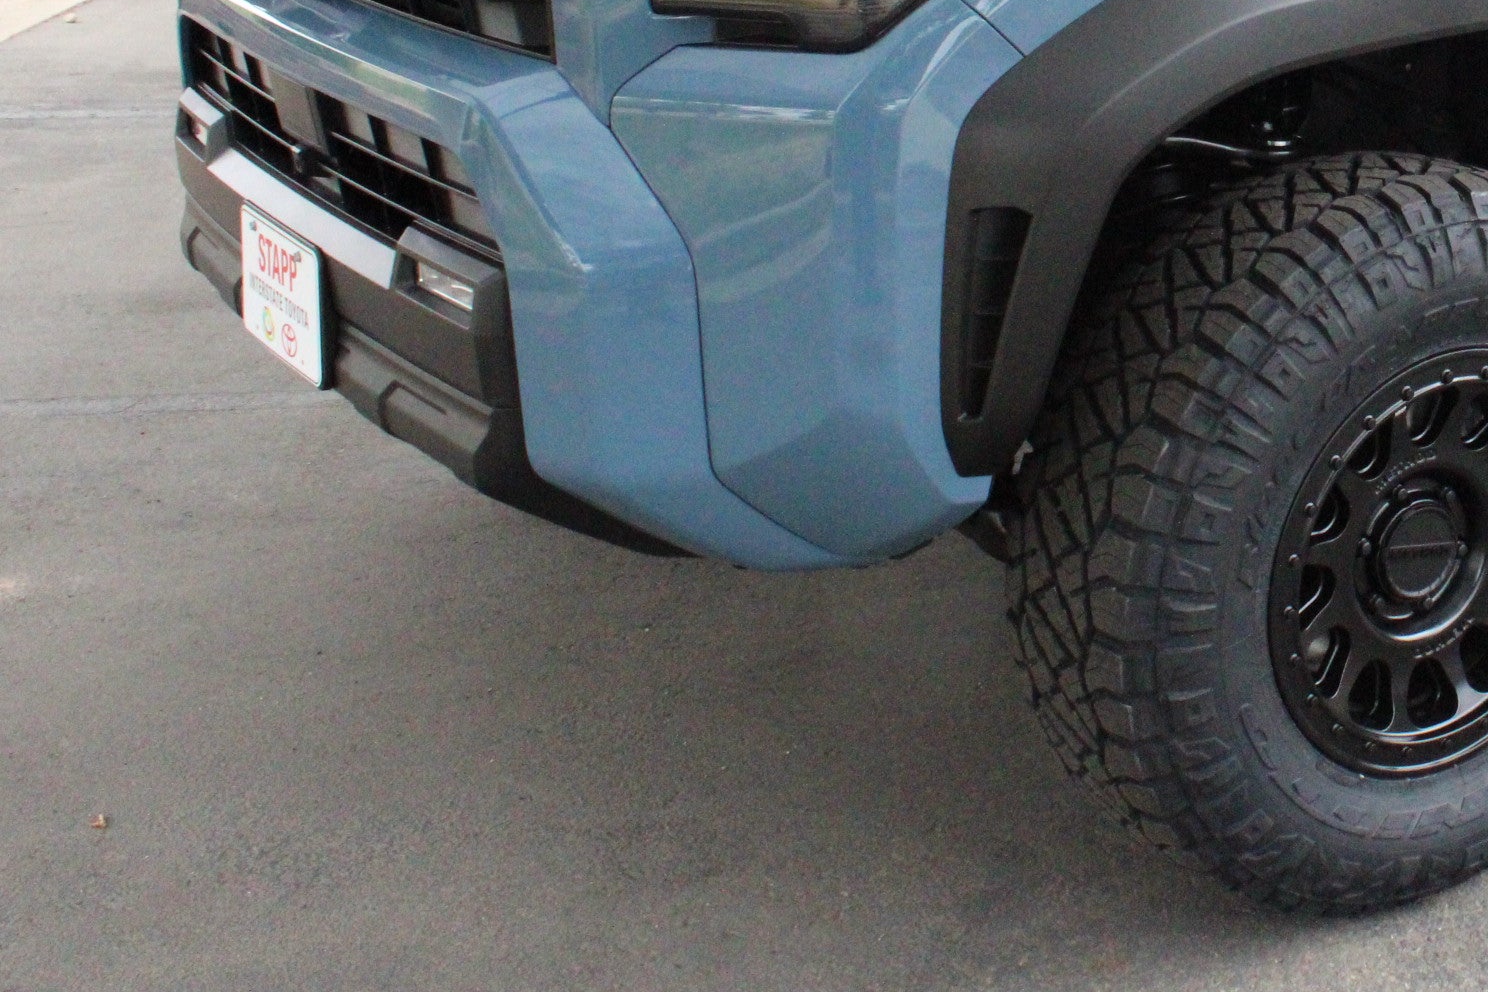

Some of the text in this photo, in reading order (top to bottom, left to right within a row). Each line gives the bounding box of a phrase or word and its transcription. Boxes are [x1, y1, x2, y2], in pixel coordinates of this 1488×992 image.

[259, 235, 298, 292] STAPP
[249, 272, 309, 329] INTERSTATE TOYOTA
